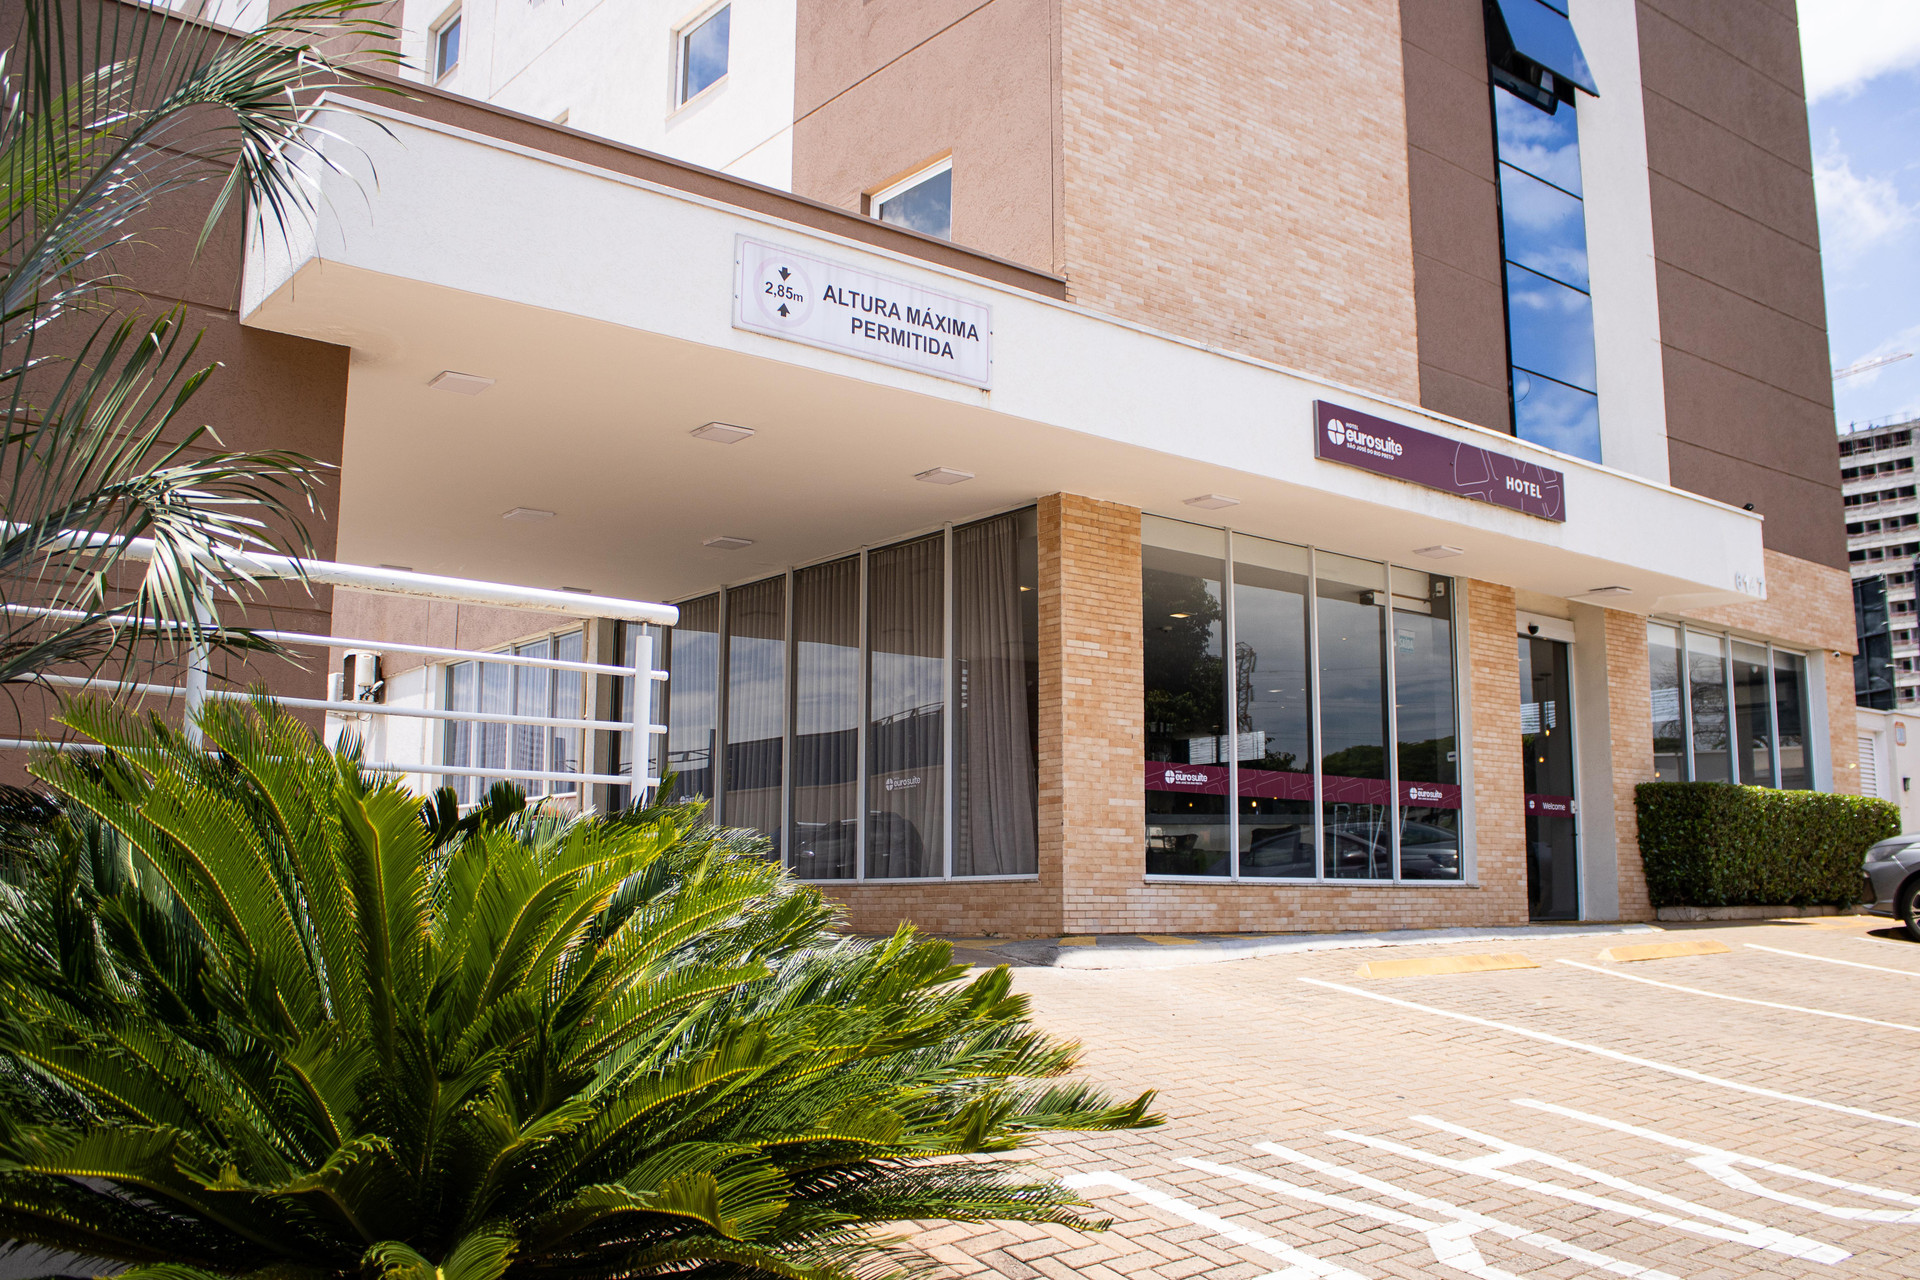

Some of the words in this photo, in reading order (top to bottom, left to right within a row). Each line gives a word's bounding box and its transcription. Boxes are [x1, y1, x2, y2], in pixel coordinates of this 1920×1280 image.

[765, 281, 804, 303] 2,85m
[822, 284, 901, 321] ALTURA
[906, 307, 980, 342] MÁXIMA
[851, 316, 954, 360] PERMITIDA
[1345, 428, 1403, 457] eurosuite
[1506, 475, 1542, 499] HOTEL
[1542, 802, 1566, 811] Welcome
